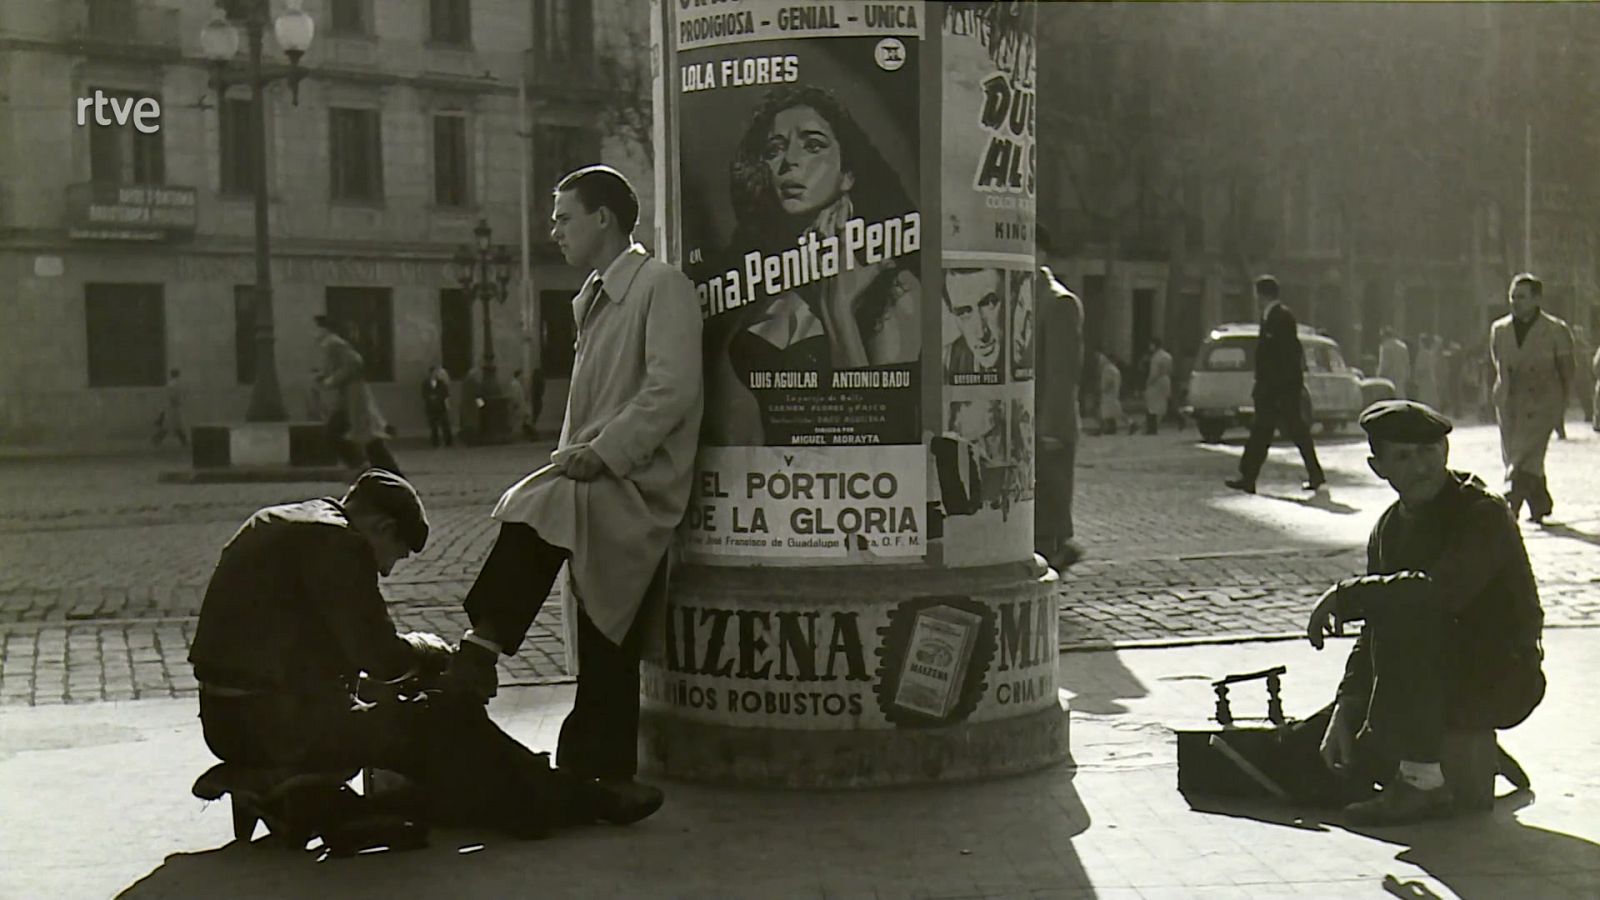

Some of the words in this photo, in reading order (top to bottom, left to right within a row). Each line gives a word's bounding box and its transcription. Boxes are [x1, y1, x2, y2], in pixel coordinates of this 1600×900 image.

[680, 11, 754, 44] PRODIGIOSA
[778, 5, 839, 31] GENIAL
[864, 5, 917, 28] UNICA
[681, 63, 715, 93] LOLA
[721, 55, 798, 87] FLORES
[744, 232, 839, 302] Penita
[845, 212, 920, 271] Pena
[750, 371, 772, 389] LUIS
[774, 371, 818, 389] AGUILAR
[832, 371, 880, 388] ANTONIO
[882, 371, 910, 388] BADU
[791, 434, 826, 445] MIGUEL
[832, 434, 880, 444] MORAYTA
[702, 471, 728, 498] EL
[746, 469, 899, 500] PÓRTICO
[689, 505, 716, 532] DE
[733, 507, 768, 534] LA
[789, 507, 917, 535] GLORIA
[726, 535, 767, 547] Francisco
[771, 536, 782, 547] de
[787, 536, 839, 549] Guadalupe
[728, 689, 863, 716] ROBUSTOS
